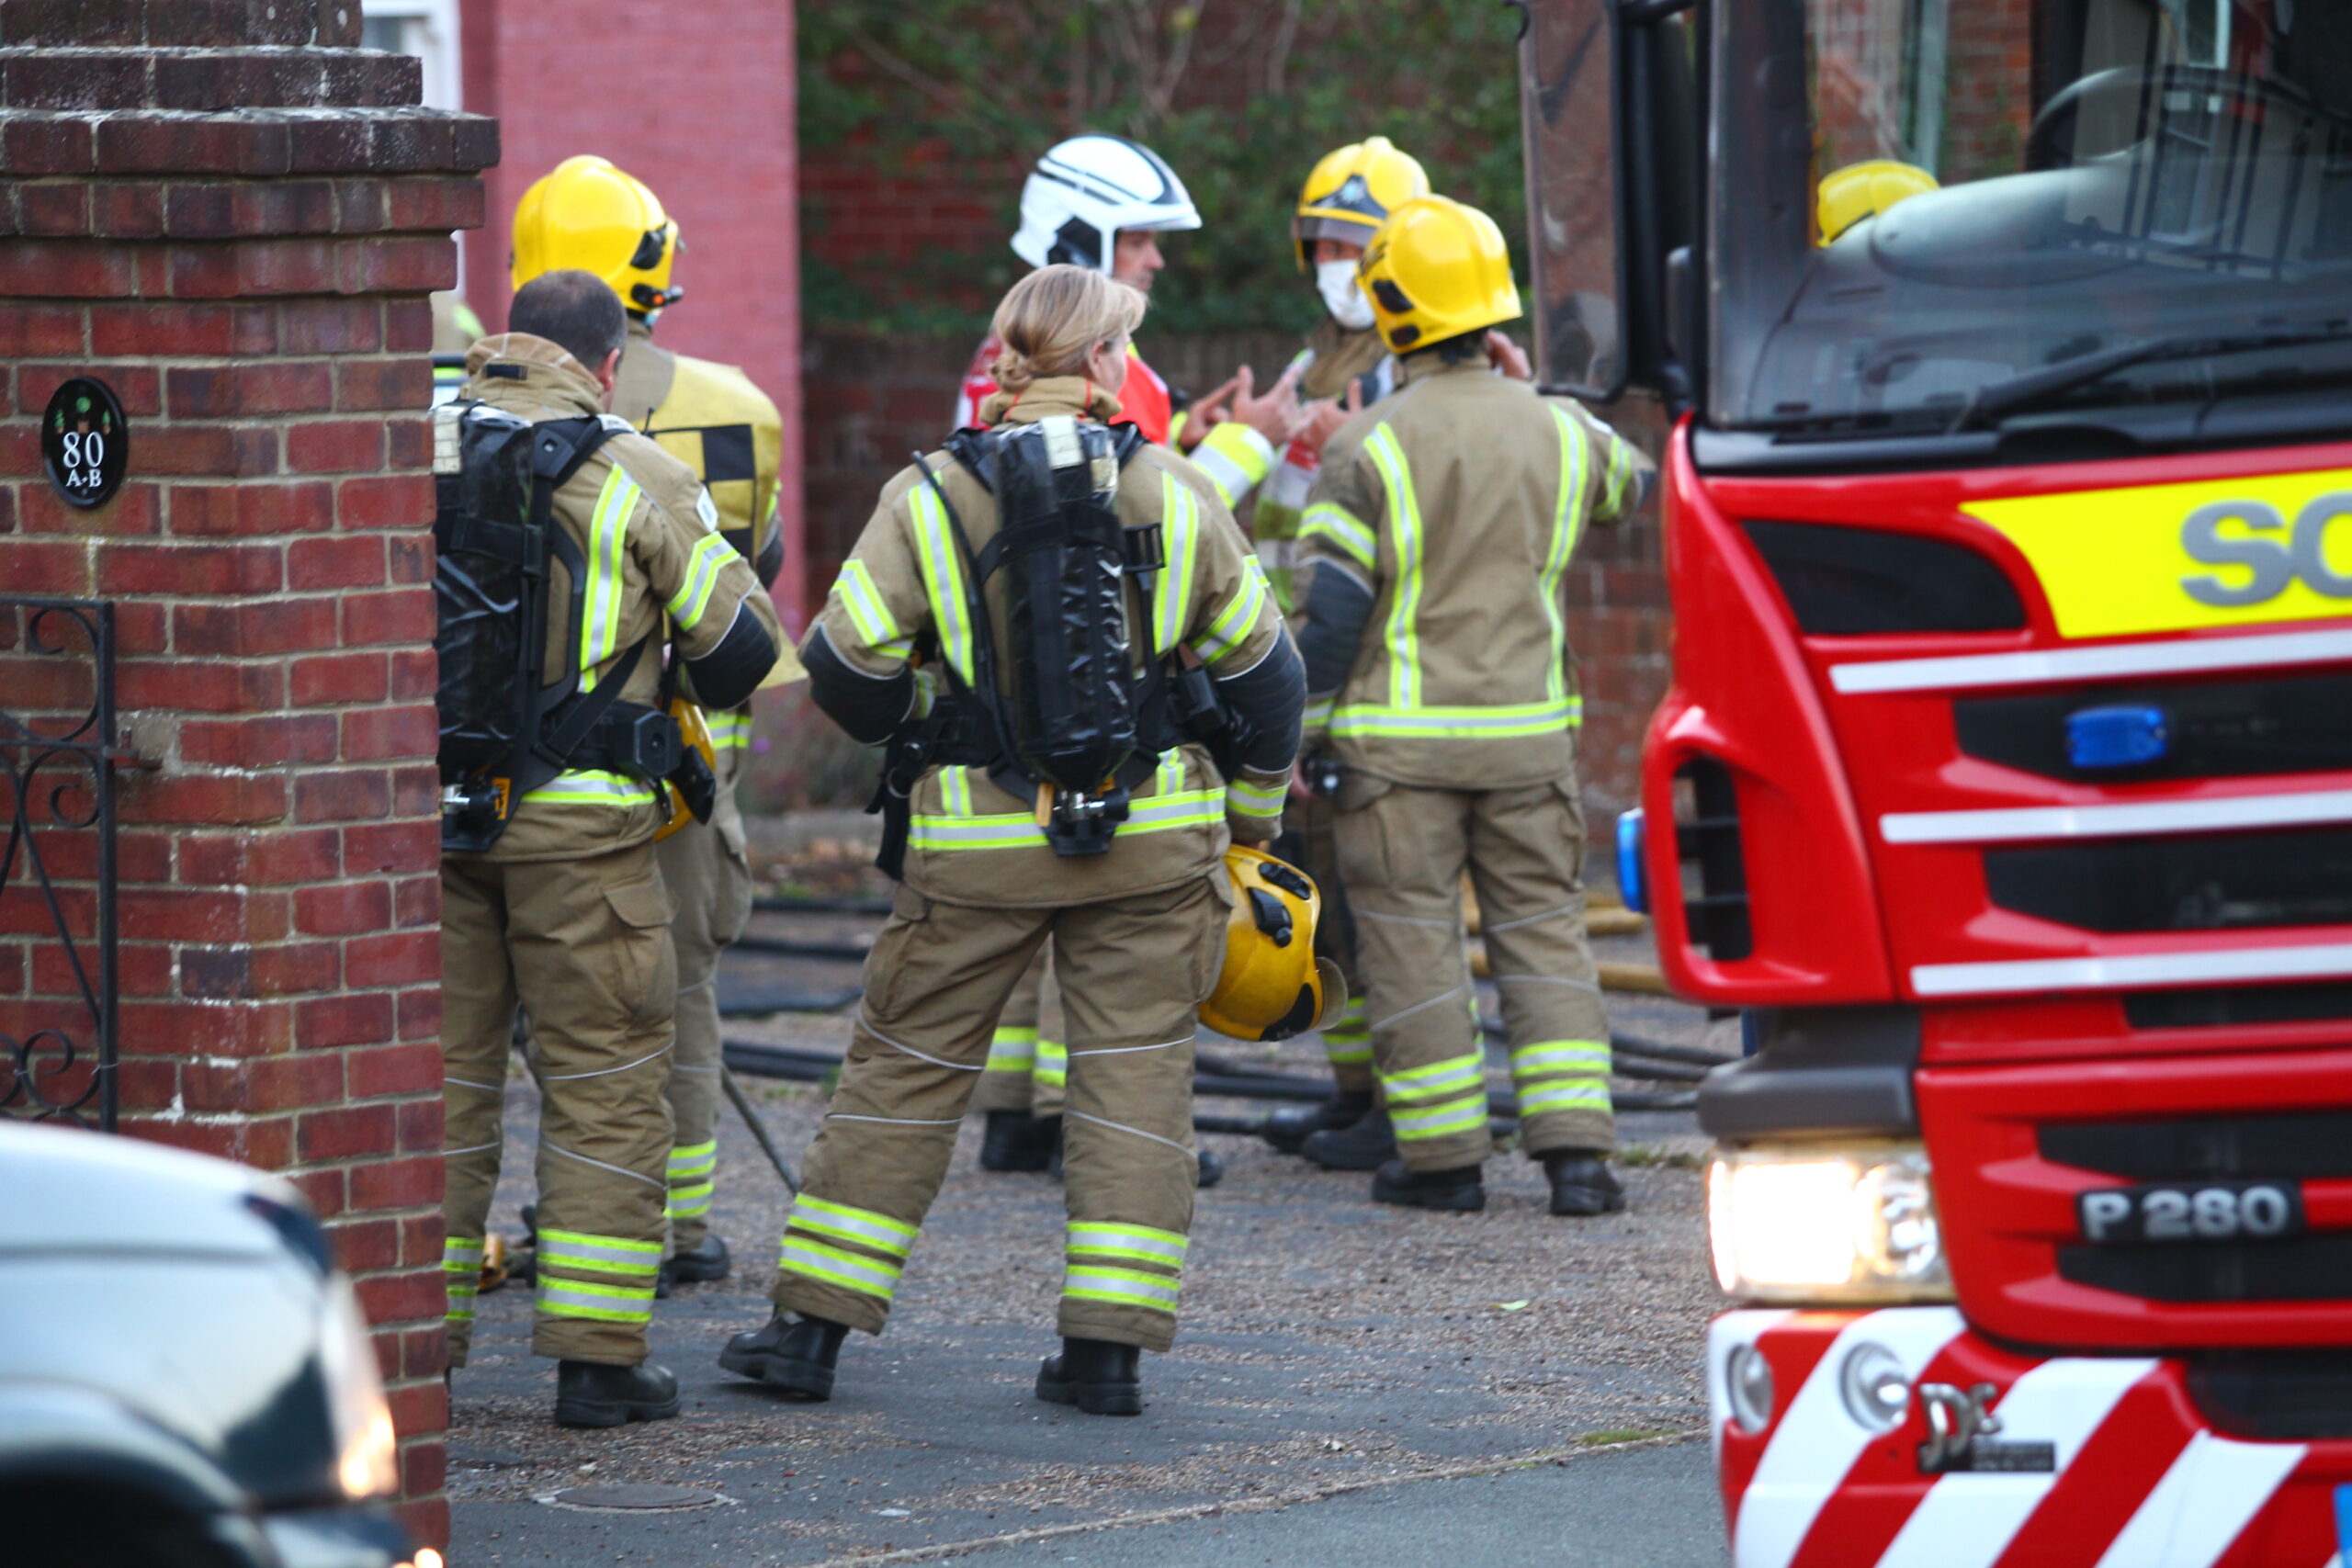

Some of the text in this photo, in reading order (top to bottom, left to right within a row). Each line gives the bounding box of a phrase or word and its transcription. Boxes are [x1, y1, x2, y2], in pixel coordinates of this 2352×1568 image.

[62, 431, 104, 468] 80
[2082, 1184, 2289, 1241] P 280
